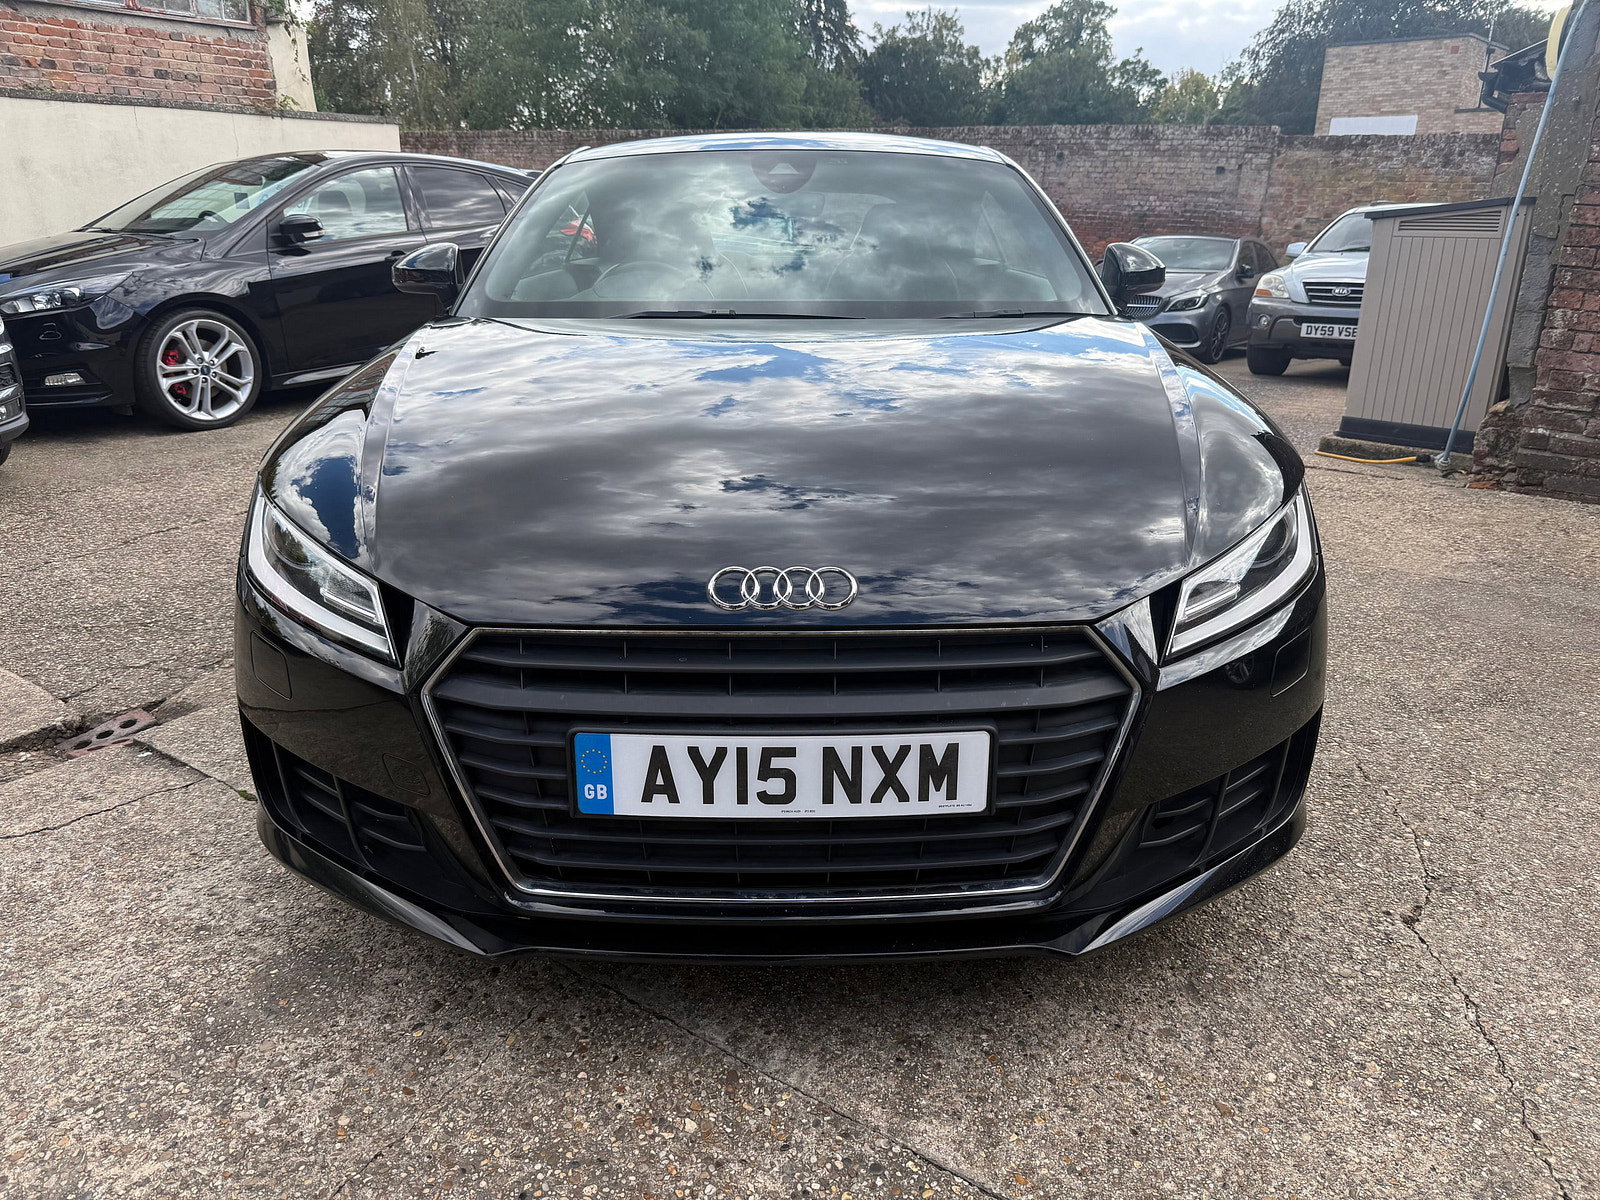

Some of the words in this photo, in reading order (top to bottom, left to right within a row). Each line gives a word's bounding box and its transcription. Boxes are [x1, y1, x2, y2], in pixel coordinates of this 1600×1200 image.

[1306, 325, 1335, 336] DY59
[640, 744, 797, 805] AY15
[822, 742, 960, 804] NXM
[584, 783, 608, 800] GB
